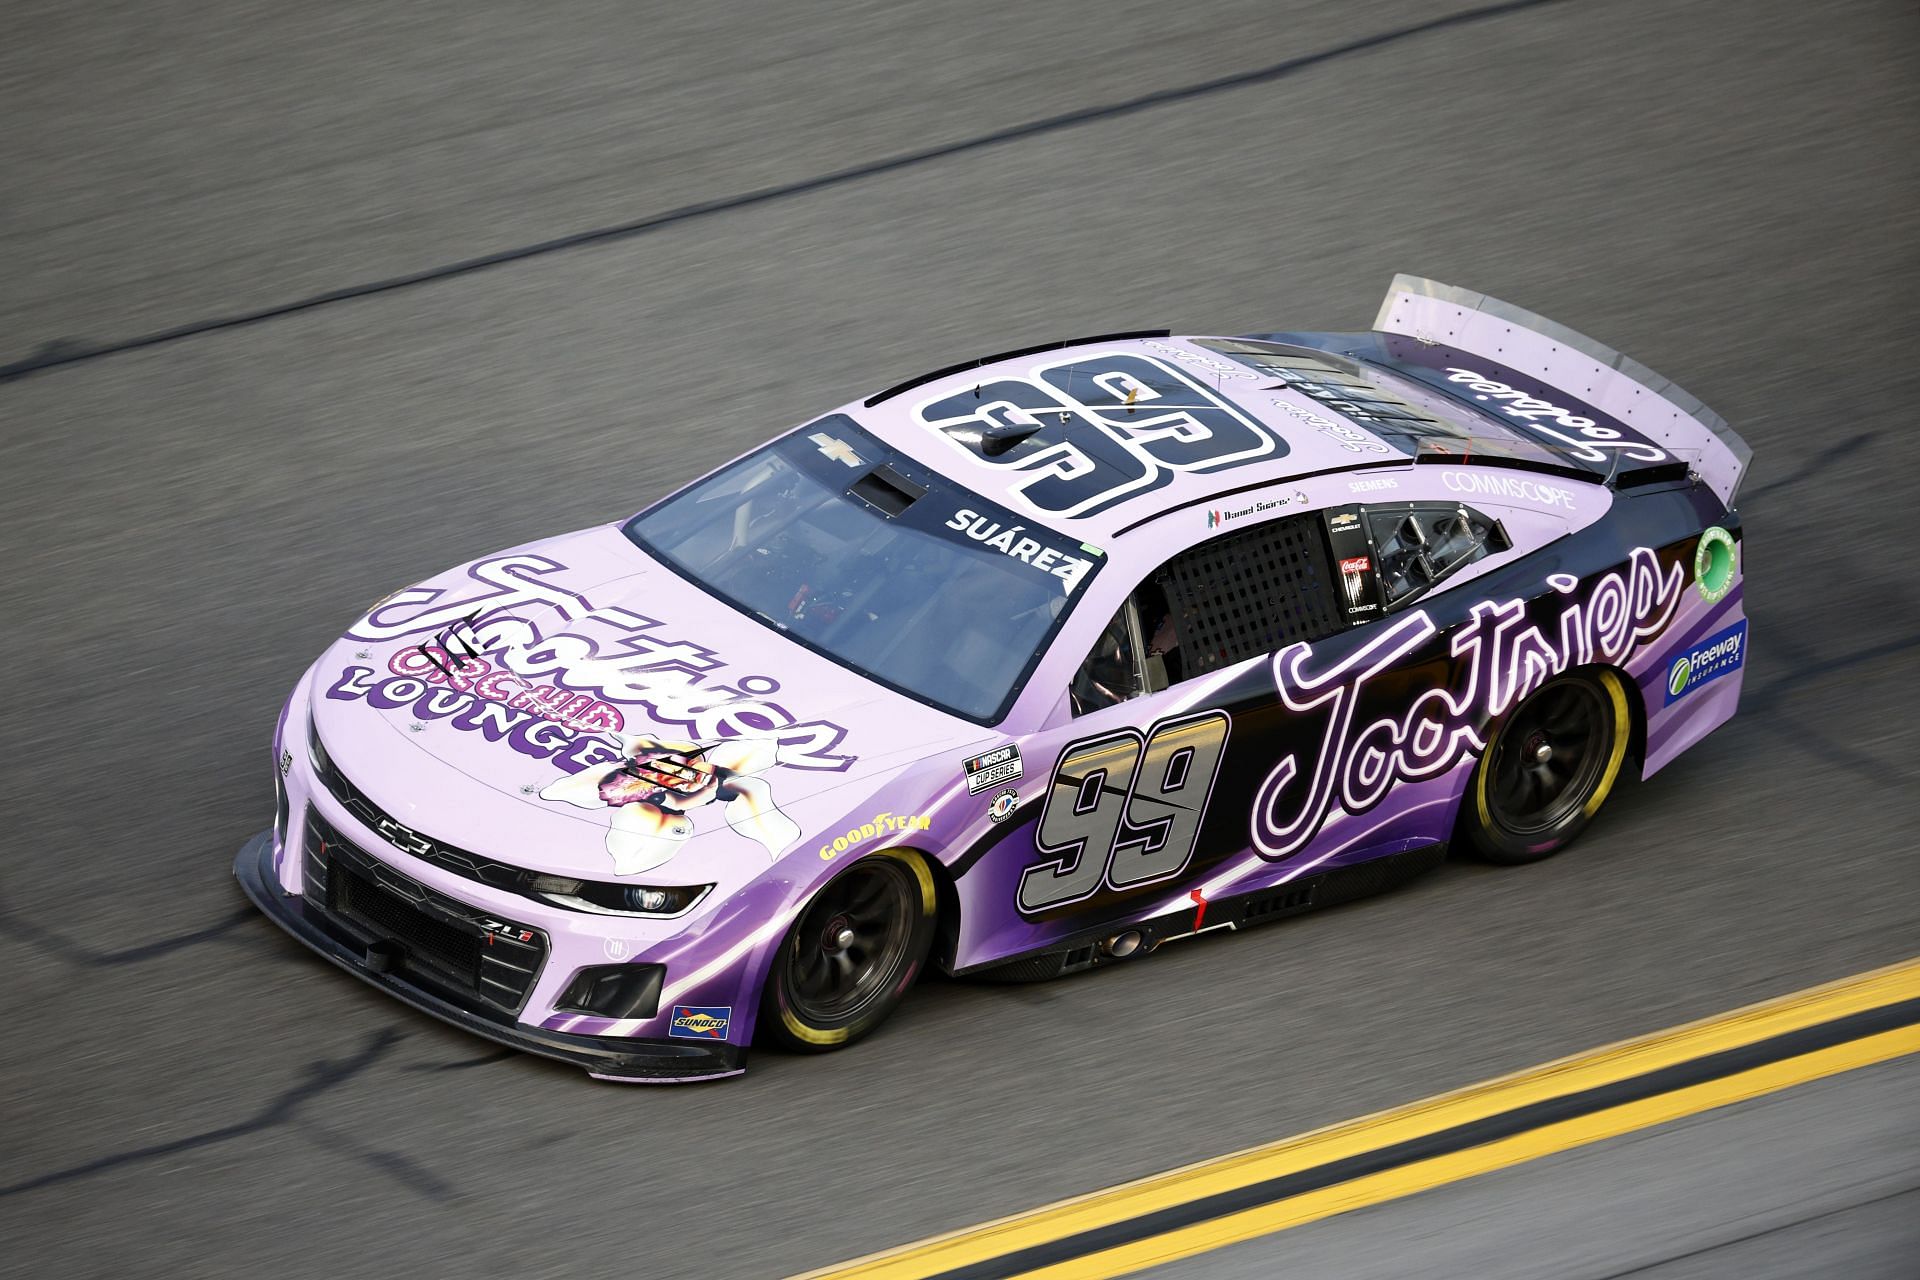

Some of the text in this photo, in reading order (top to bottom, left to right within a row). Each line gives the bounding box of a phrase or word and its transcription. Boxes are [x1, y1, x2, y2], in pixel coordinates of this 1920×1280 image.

[911, 351, 1285, 519] 99
[1446, 368, 1667, 462] Tootsies
[1348, 478, 1398, 493] SIEMENS
[1441, 471, 1577, 510] COMMSCOPE
[945, 509, 1094, 584] SUÁREZ
[1687, 652, 1740, 687] INSURANCE
[1690, 632, 1743, 673] Freeway
[388, 646, 625, 733] ORCHID
[326, 666, 623, 771] LOUNGE
[976, 763, 1015, 785] CUP SERIES
[982, 748, 1011, 768] NASCAR
[1016, 708, 1233, 915] 99
[819, 812, 931, 860] GOODYEAR
[480, 919, 533, 942] ZL1
[675, 1016, 728, 1028] SUNOCO
